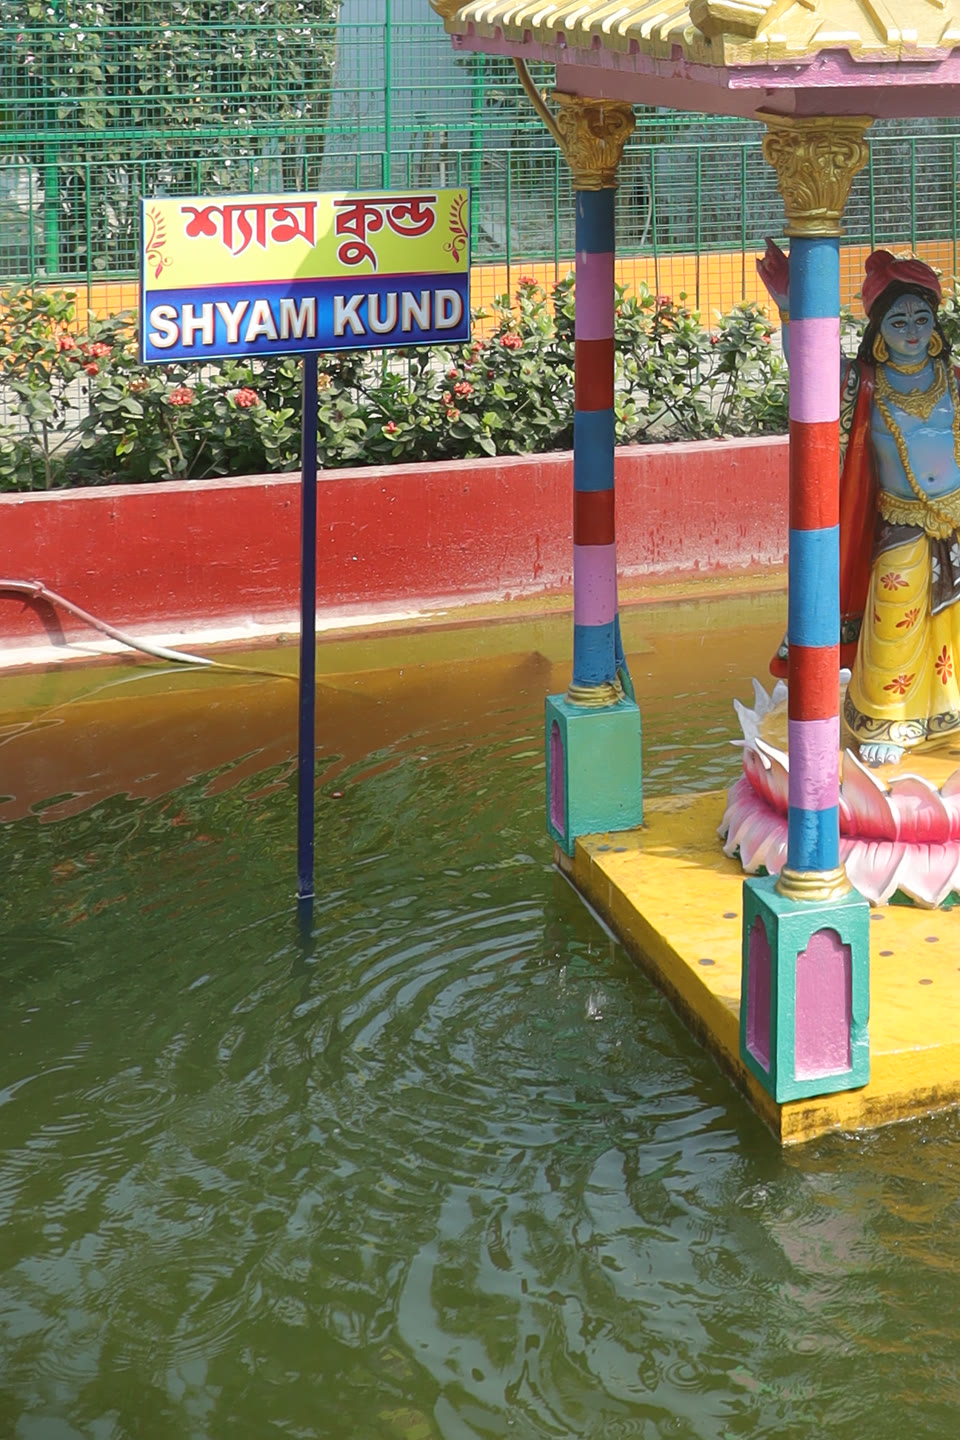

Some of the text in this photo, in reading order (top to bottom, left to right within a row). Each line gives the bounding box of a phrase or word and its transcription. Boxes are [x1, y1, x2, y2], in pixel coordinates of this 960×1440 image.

[181, 196, 436, 271] শ্যাম কুন্ড
[149, 290, 463, 348] SHYAM KUND
